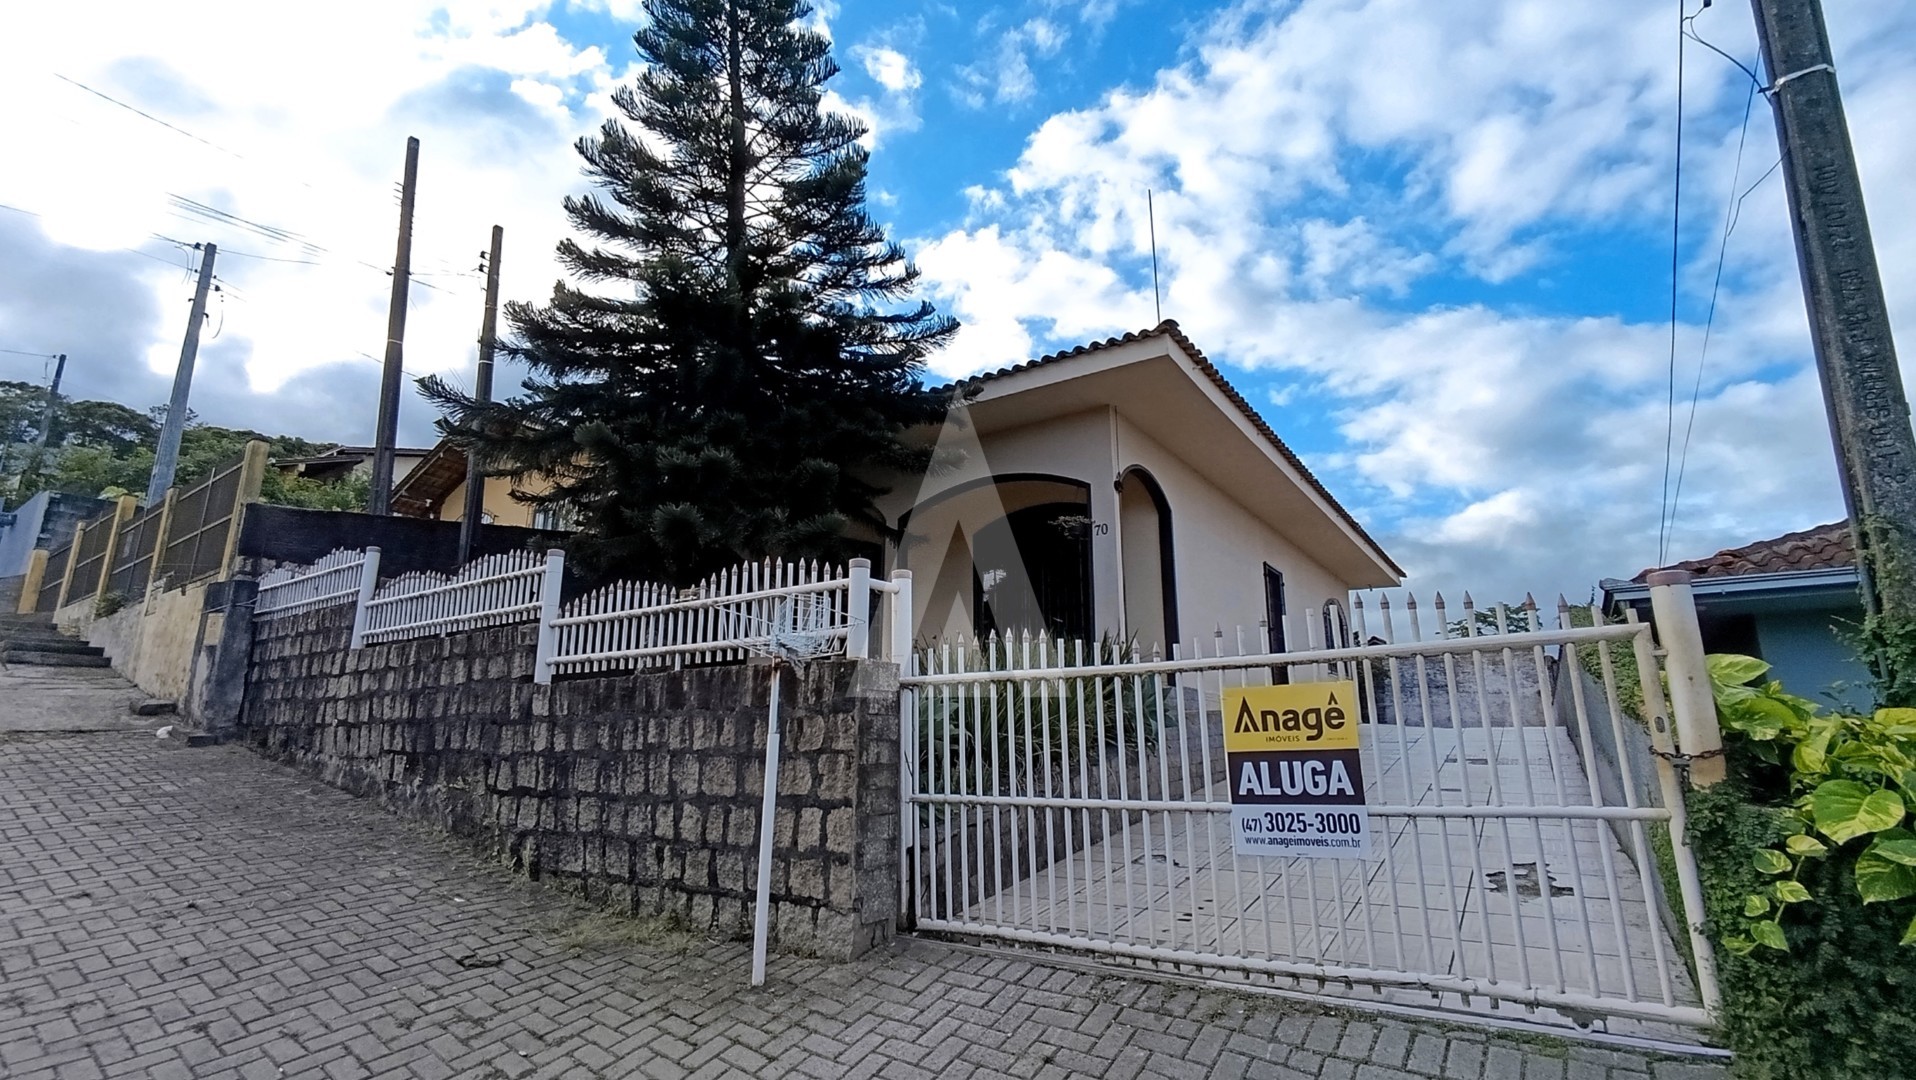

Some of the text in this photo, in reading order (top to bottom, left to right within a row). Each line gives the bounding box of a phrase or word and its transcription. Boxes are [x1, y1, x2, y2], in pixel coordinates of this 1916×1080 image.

[1094, 523, 1109, 536] 70
[1234, 691, 1346, 741] Anagê
[1265, 735, 1301, 743] IMÓVEIS
[1238, 760, 1355, 796] ALUGA
[1241, 812, 1361, 834] (47) 3025-3000
[1244, 835, 1361, 848] www.anageimoveis.com.br
